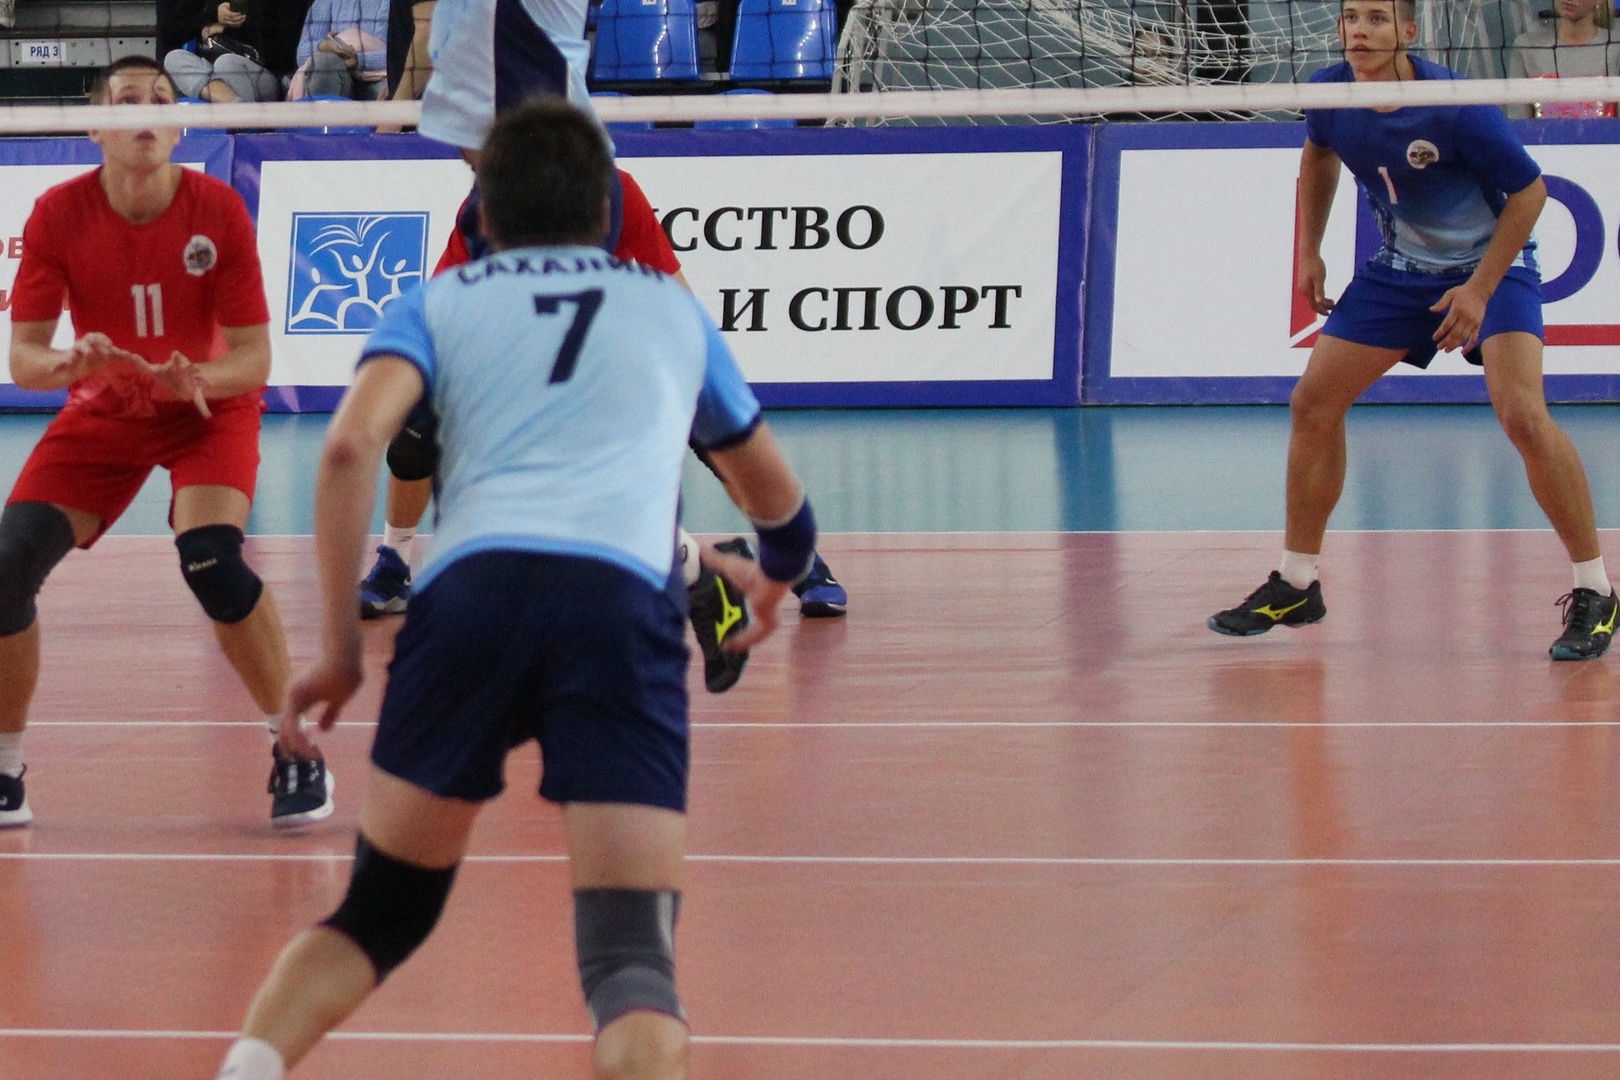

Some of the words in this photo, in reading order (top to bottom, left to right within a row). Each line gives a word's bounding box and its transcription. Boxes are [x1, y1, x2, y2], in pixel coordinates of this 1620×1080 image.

[30, 46, 50, 58] РЯД
[653, 205, 885, 251] ССТВО
[131, 283, 164, 337] 11
[719, 288, 770, 332] И
[789, 285, 1022, 332] СПОРТ
[534, 286, 606, 386] 7
